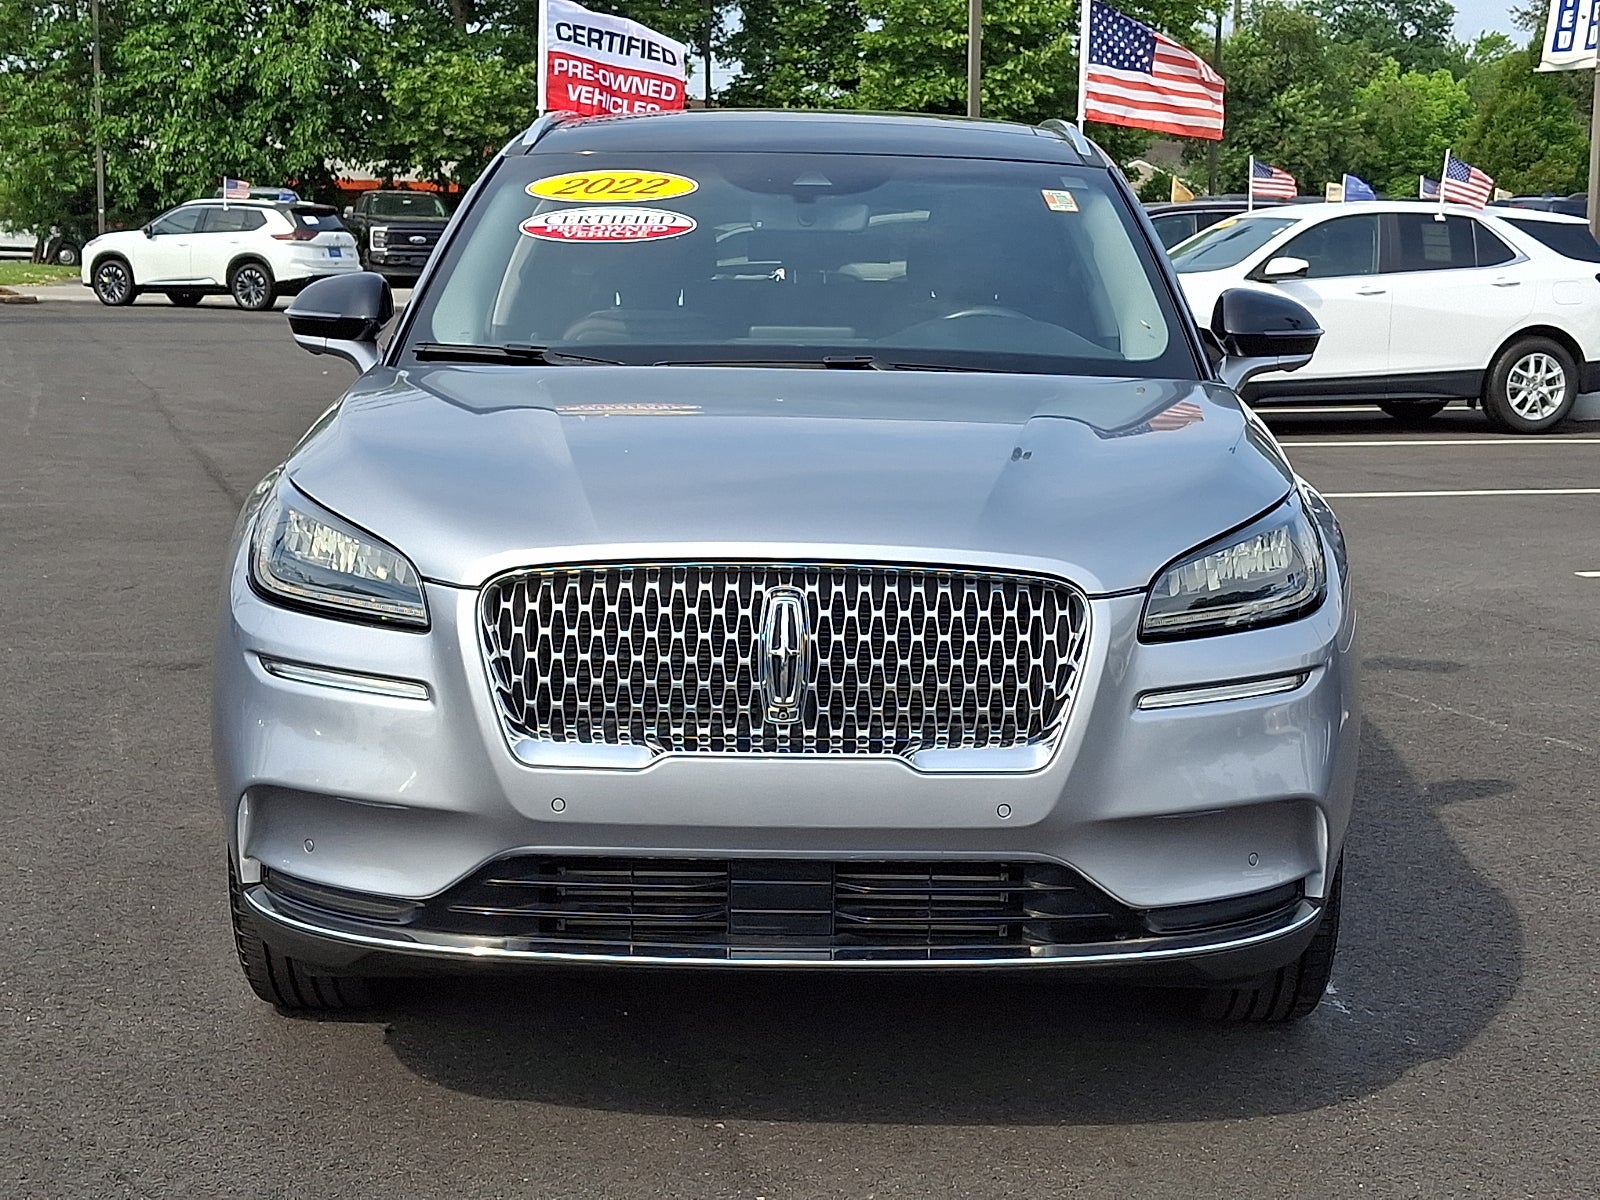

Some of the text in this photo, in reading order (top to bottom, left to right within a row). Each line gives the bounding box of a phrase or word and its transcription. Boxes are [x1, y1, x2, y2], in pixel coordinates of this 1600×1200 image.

[555, 21, 677, 66] CERTIFIED
[553, 58, 676, 101] PRE-OWNED
[552, 177, 671, 195] 2022
[544, 214, 677, 225] CERTIFIED
[545, 224, 669, 233] PRE-OWNED
[562, 230, 650, 239] VEHICLE
